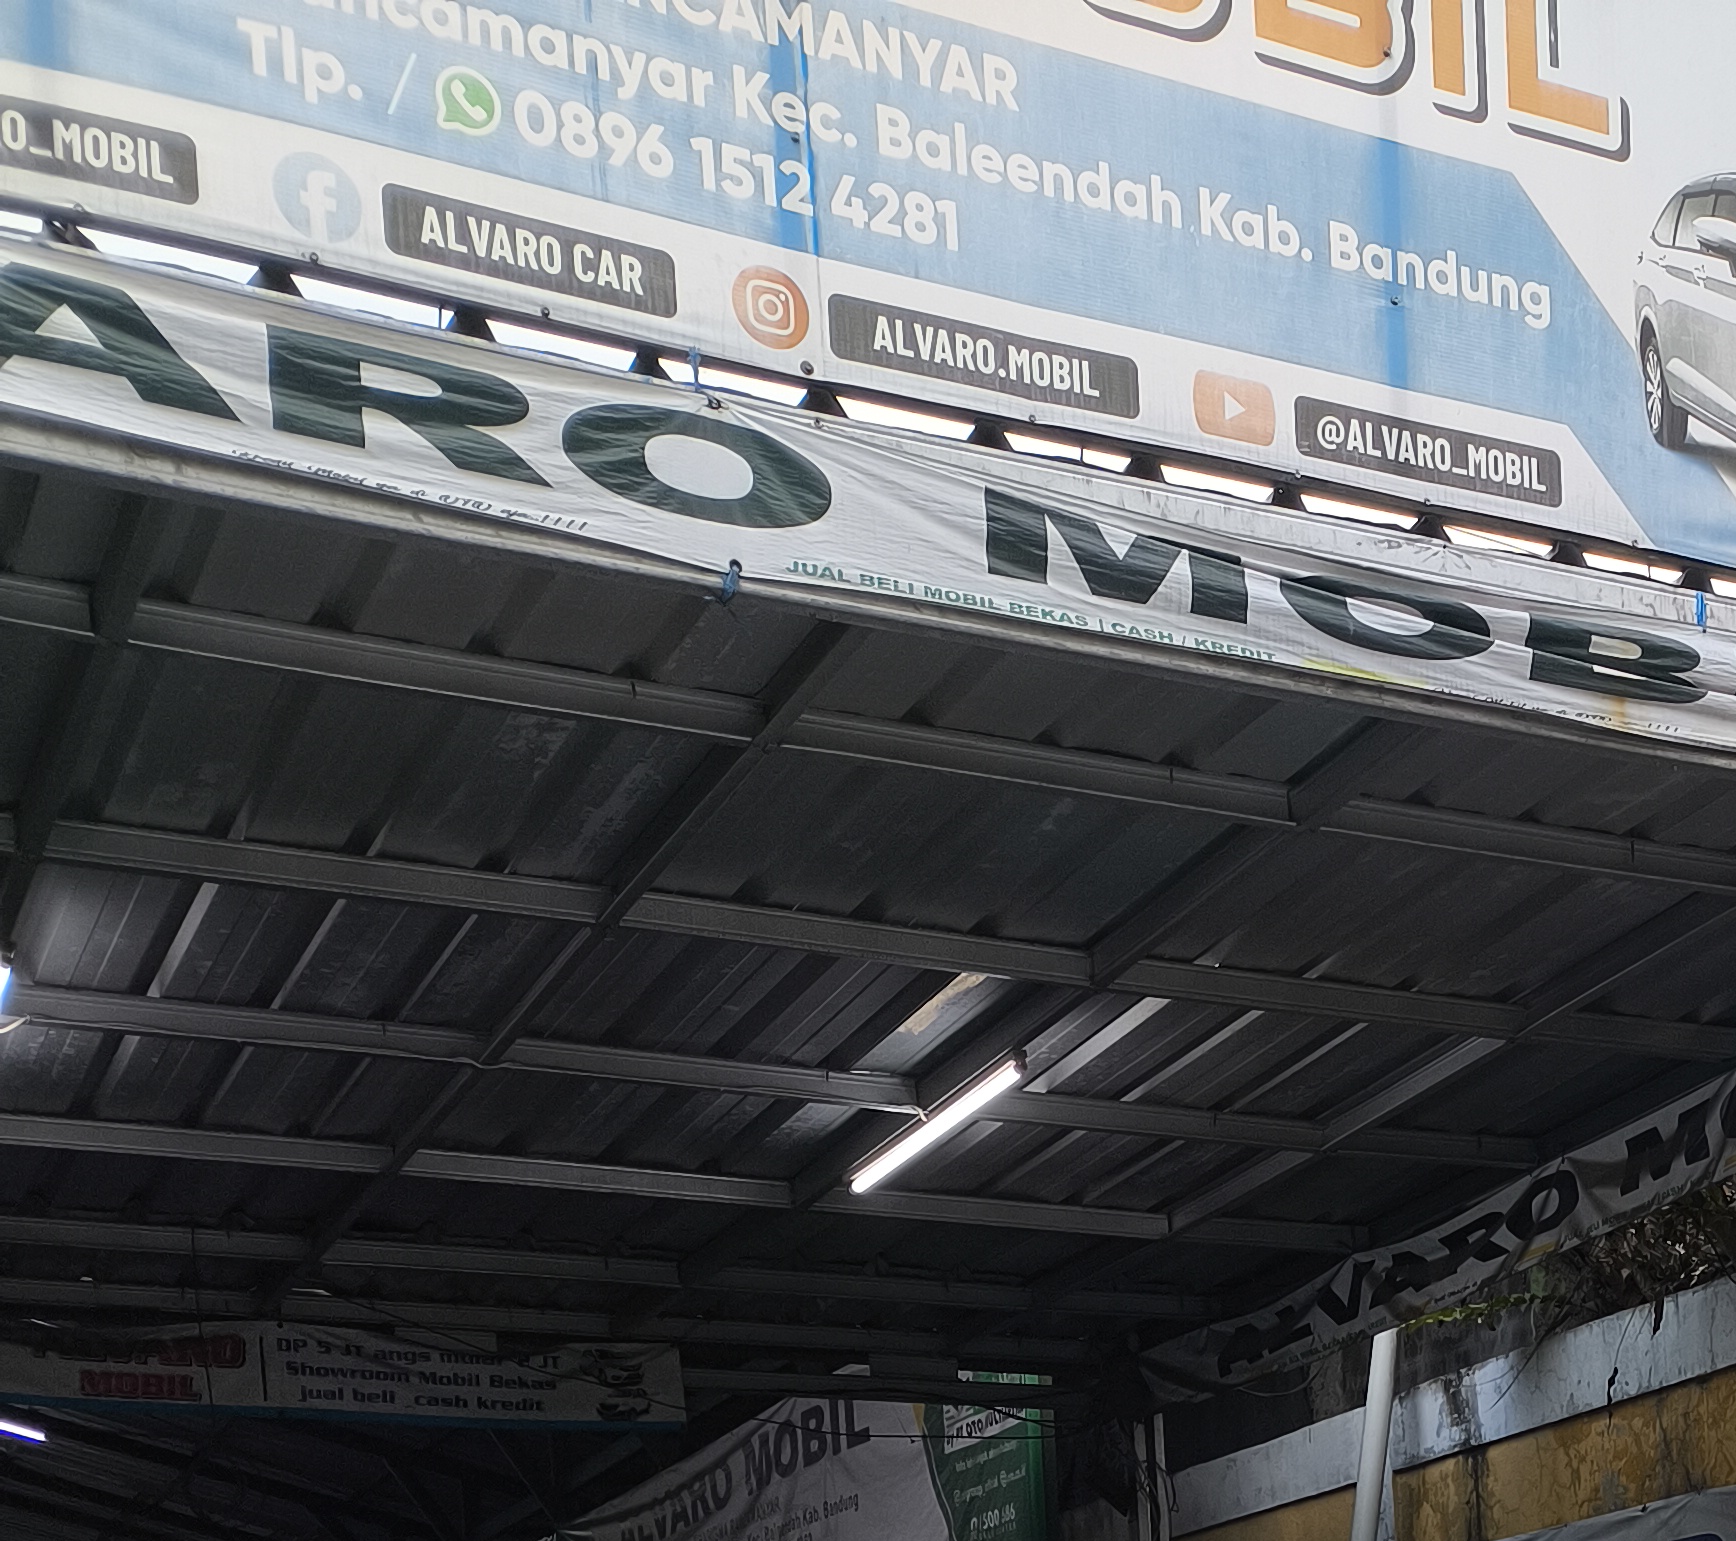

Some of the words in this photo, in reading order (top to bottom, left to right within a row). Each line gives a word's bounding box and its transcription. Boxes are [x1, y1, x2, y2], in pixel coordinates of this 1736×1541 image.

[632, 0, 1019, 111] CAMANYAR
[236, 16, 363, 104] Tlp.
[513, 89, 674, 178] 0896
[689, 137, 814, 217] 1512
[830, 175, 959, 251] 4281
[733, 64, 857, 148] Kec.
[877, 103, 1182, 224] Baleendah
[1199, 186, 1313, 262] Kab.
[1331, 220, 1551, 330] Bandung
[420, 204, 562, 276] ALVARO
[573, 241, 645, 296] CAR
[873, 316, 1101, 400] ALVARO.MOBIL
[1316, 409, 1547, 493] @ALVARO_MOBIL
[785, 559, 854, 585] JUAL
[859, 572, 916, 597] BELI
[923, 584, 1002, 611] MOBIL
[1008, 601, 1090, 629] BEKAS
[1110, 621, 1174, 645] CASH
[80, 1369, 202, 1402] MOBIL
[276, 1337, 308, 1354] DP
[374, 1346, 432, 1366] angs
[285, 1360, 410, 1383] Showroom
[419, 1370, 481, 1388] Mobil
[489, 1374, 558, 1392] Bekas
[298, 1385, 345, 1403] jual
[352, 1387, 397, 1405] beli
[414, 1394, 469, 1410] cash
[476, 1396, 545, 1413] kredit
[741, 1398, 871, 1497] MOBIL
